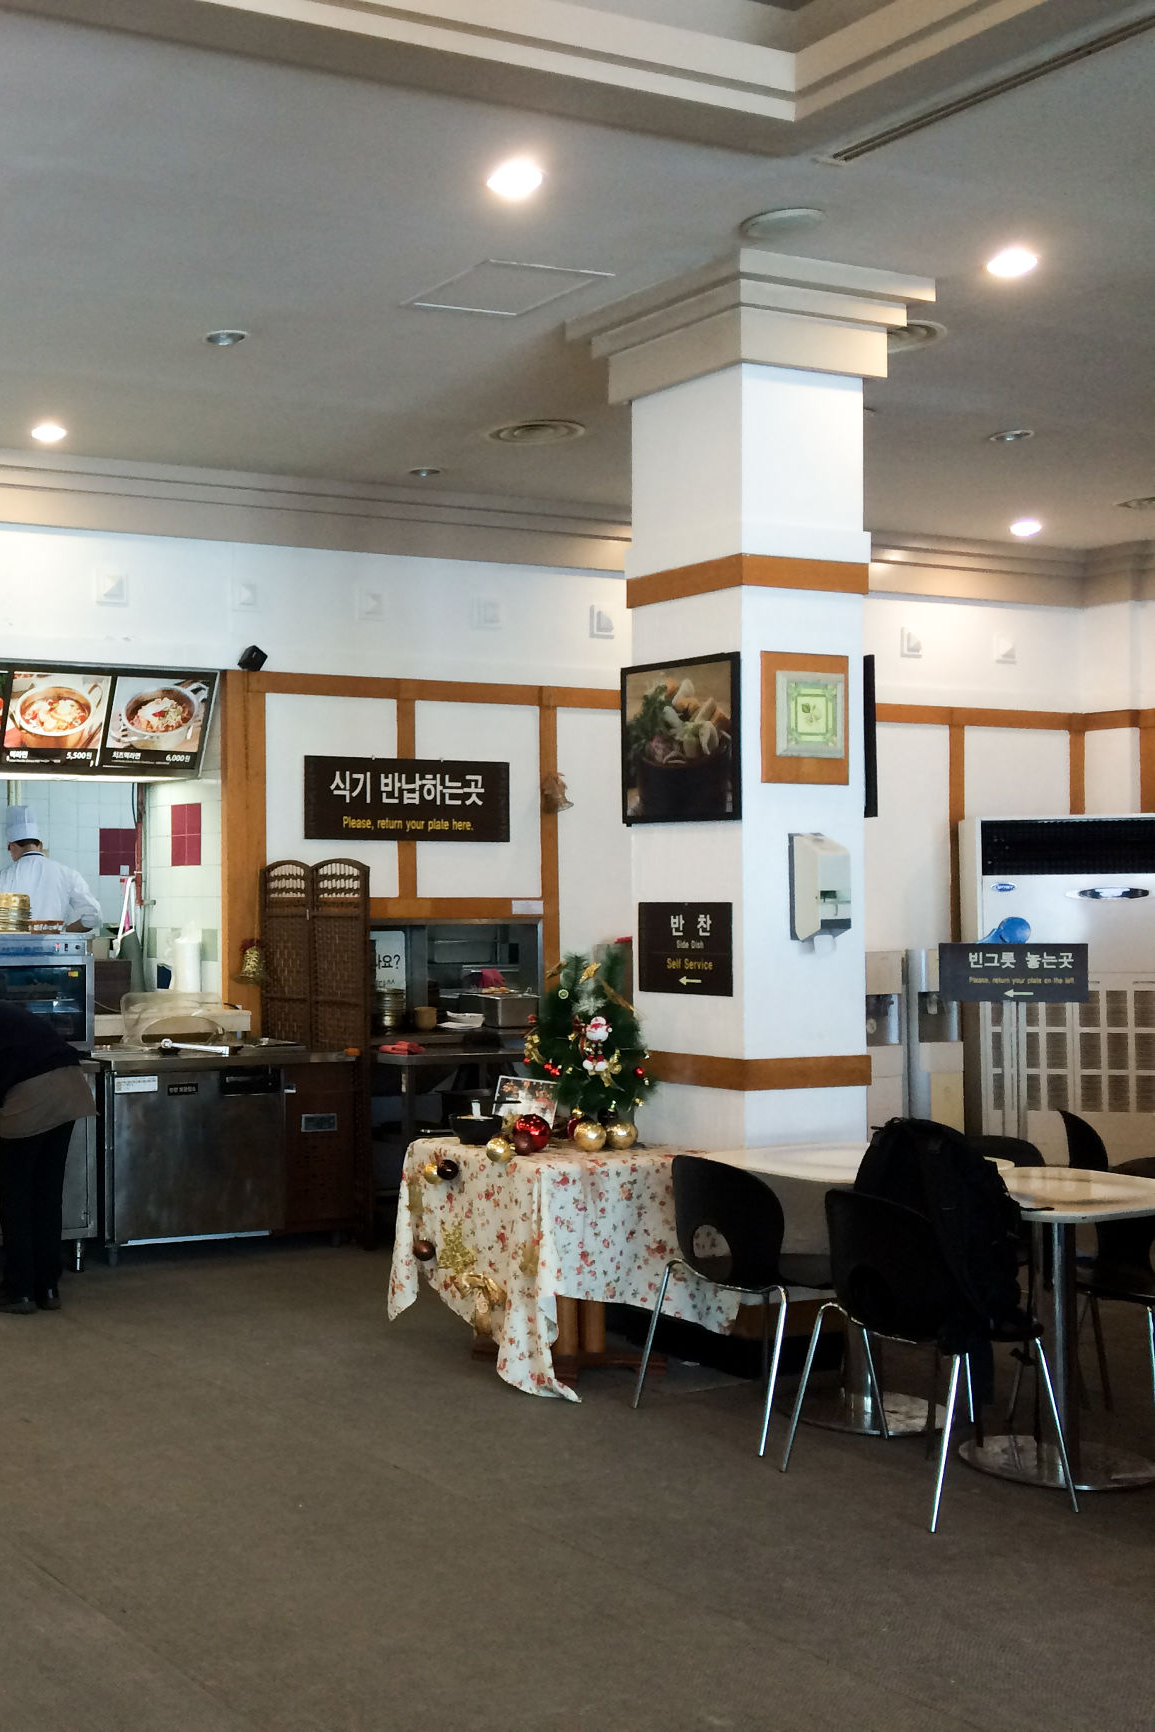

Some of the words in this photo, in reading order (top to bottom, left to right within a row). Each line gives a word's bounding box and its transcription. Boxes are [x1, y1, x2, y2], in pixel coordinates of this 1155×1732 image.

[66, 752, 92, 760] 5,500원
[165, 754, 191, 762] 6,000원
[330, 770, 371, 804] 식기
[380, 772, 485, 806] 반납하는곳
[342, 815, 374, 831] Please,
[377, 817, 403, 829] return
[406, 819, 425, 832] your
[427, 818, 449, 832] plate
[452, 818, 474, 831] here.
[666, 957, 682, 969] Self
[684, 958, 714, 970] Service
[968, 951, 1017, 969] 빈그릇
[1025, 951, 1075, 969] 놓는곳
